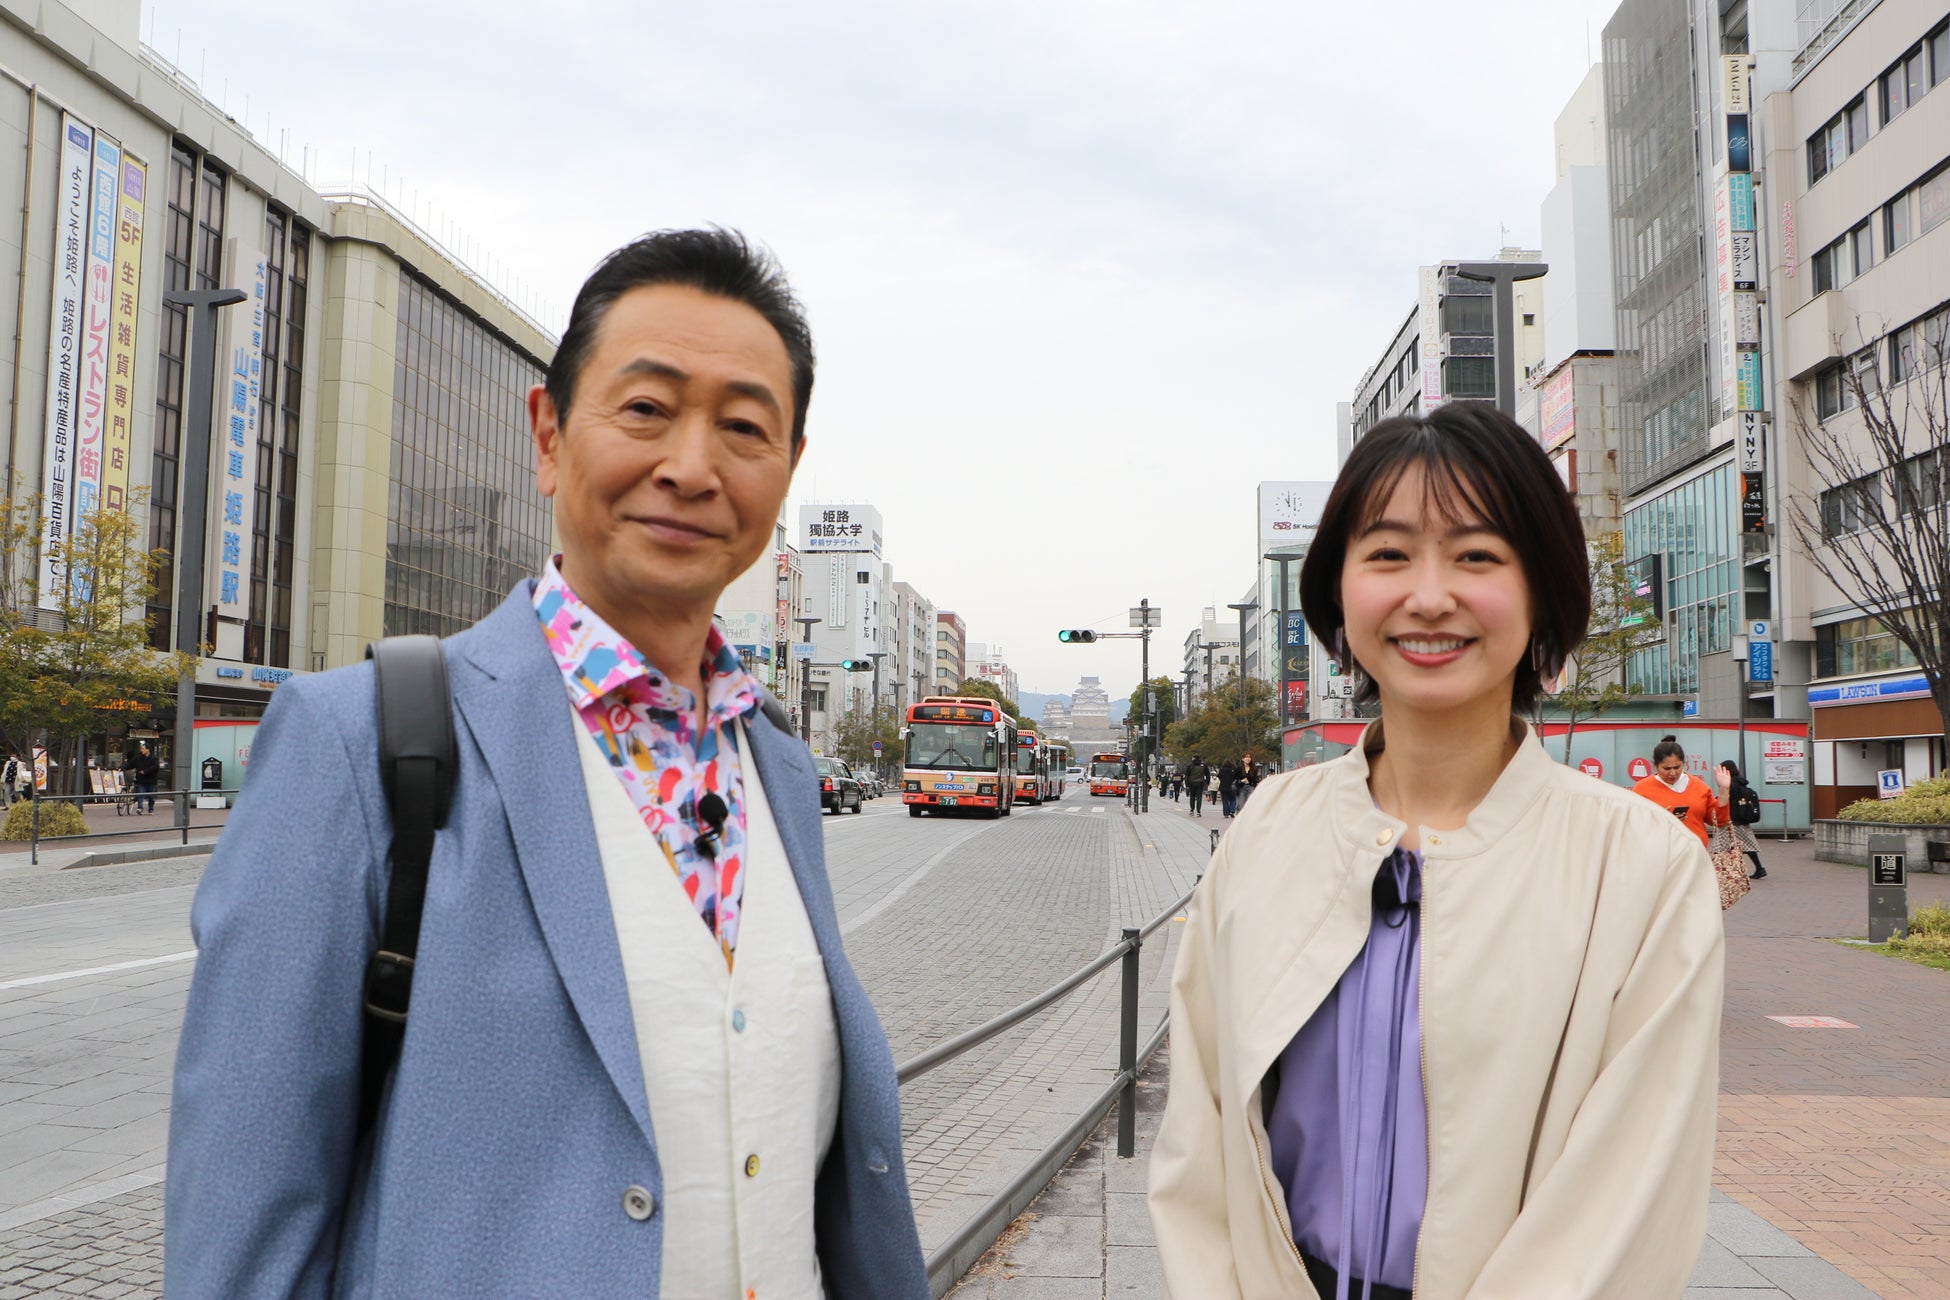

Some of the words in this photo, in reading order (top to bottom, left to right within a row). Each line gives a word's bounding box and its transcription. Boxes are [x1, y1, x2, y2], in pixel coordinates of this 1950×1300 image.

[93, 173, 114, 261] 西館6階
[120, 220, 141, 246] 5F
[1733, 236, 1742, 278] ピラティス
[1742, 236, 1751, 261] マシン
[110, 260, 135, 471] 生活雑貨専門店
[79, 304, 108, 482] レストラン街
[227, 347, 250, 481] 山陽電車
[1745, 461, 1757, 471] 3F
[822, 510, 849, 523] 姫路
[809, 524, 863, 537] 獨協大学
[809, 538, 860, 546] 駅前サテライト
[220, 489, 244, 604] 姫路駅
[1288, 618, 1300, 628] BC
[1288, 634, 1299, 644] BC
[1752, 643, 1761, 679] アイシティ
[1841, 683, 1878, 699] LAWSON
